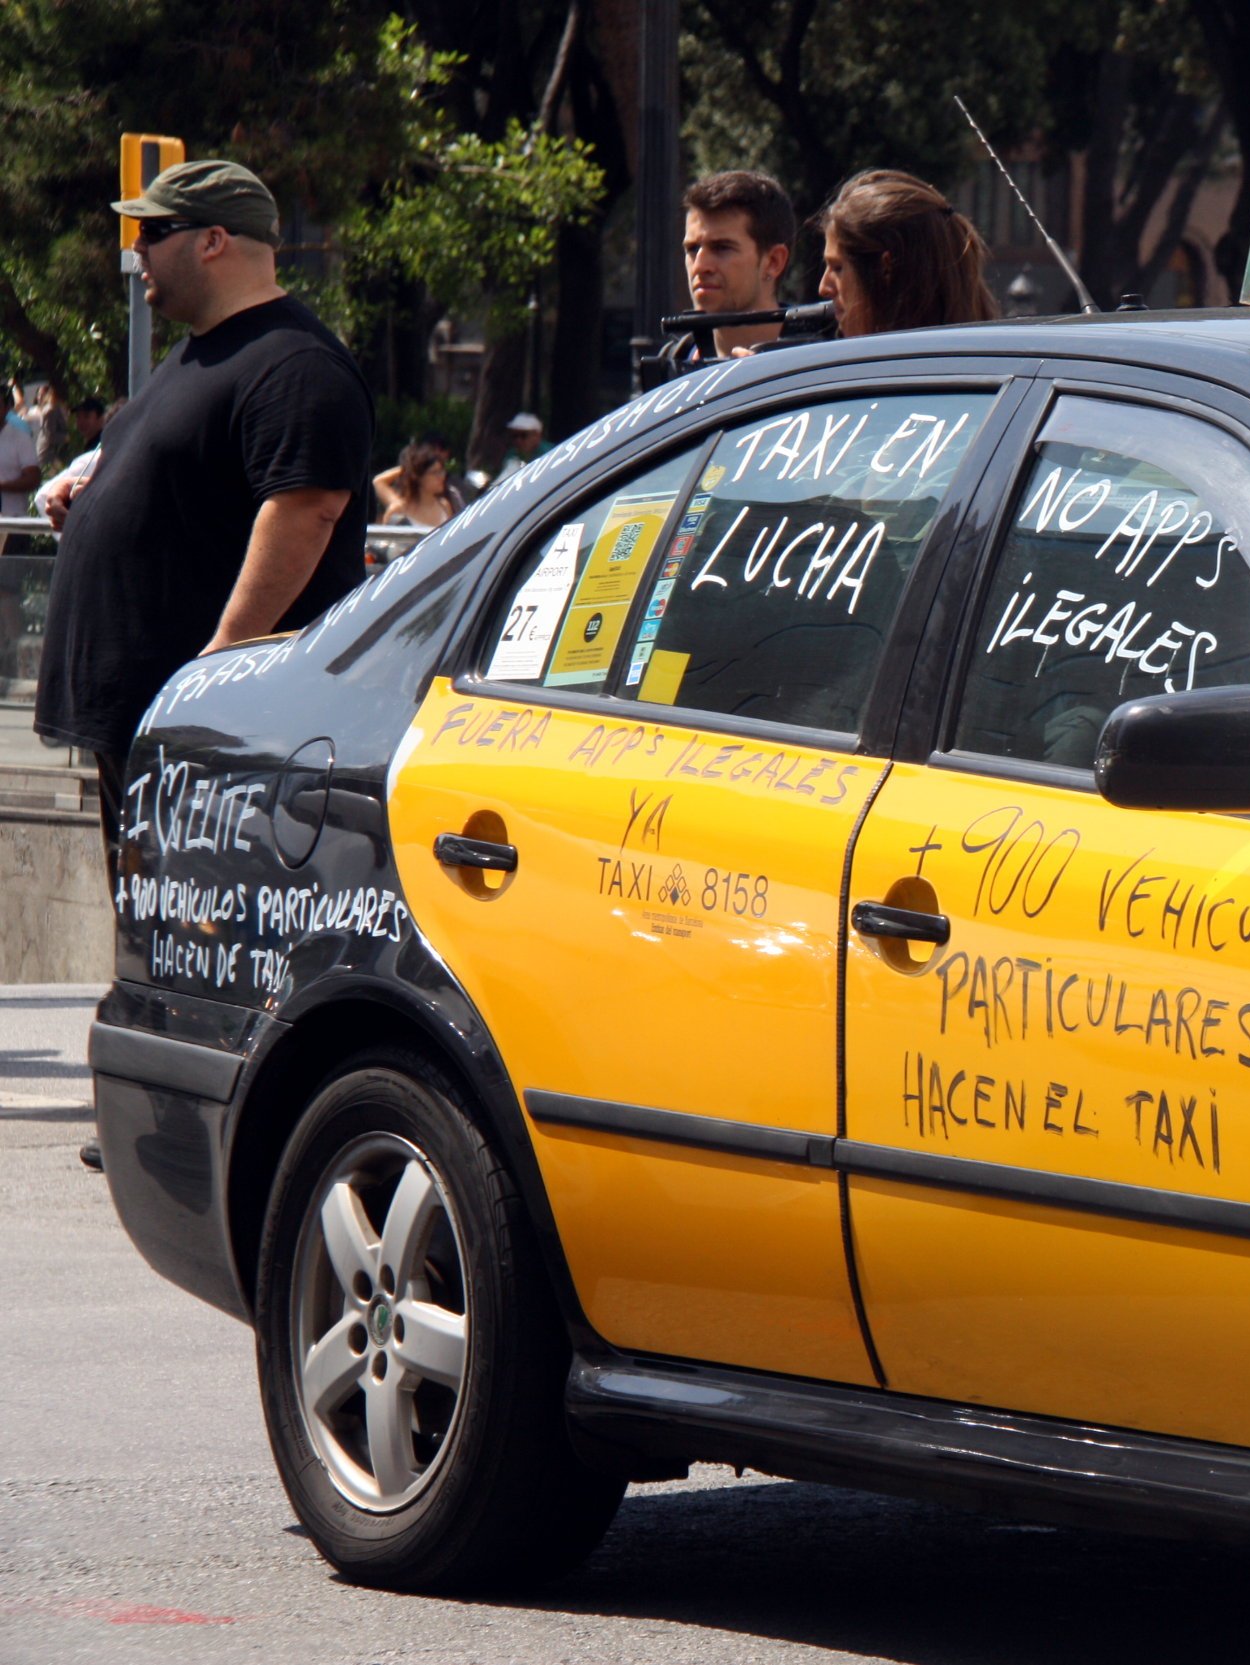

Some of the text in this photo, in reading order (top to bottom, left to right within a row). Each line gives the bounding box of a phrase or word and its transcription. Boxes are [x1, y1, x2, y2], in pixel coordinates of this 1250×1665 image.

[871, 413, 968, 478] EN
[1018, 467, 1111, 533] NO
[692, 506, 885, 614] LUCHA
[306, 574, 375, 653] YA
[501, 605, 538, 641] 27
[587, 621, 600, 631] 112
[431, 703, 552, 751] FUERA
[620, 787, 674, 854] YA
[598, 857, 768, 918] TAXI 8158
[962, 806, 1080, 918] 900
[131, 873, 157, 921] 900
[152, 930, 209, 979] HACEN
[216, 943, 242, 988] DE
[903, 1051, 1026, 1140] HACEN
[1045, 1082, 1098, 1136] EL
